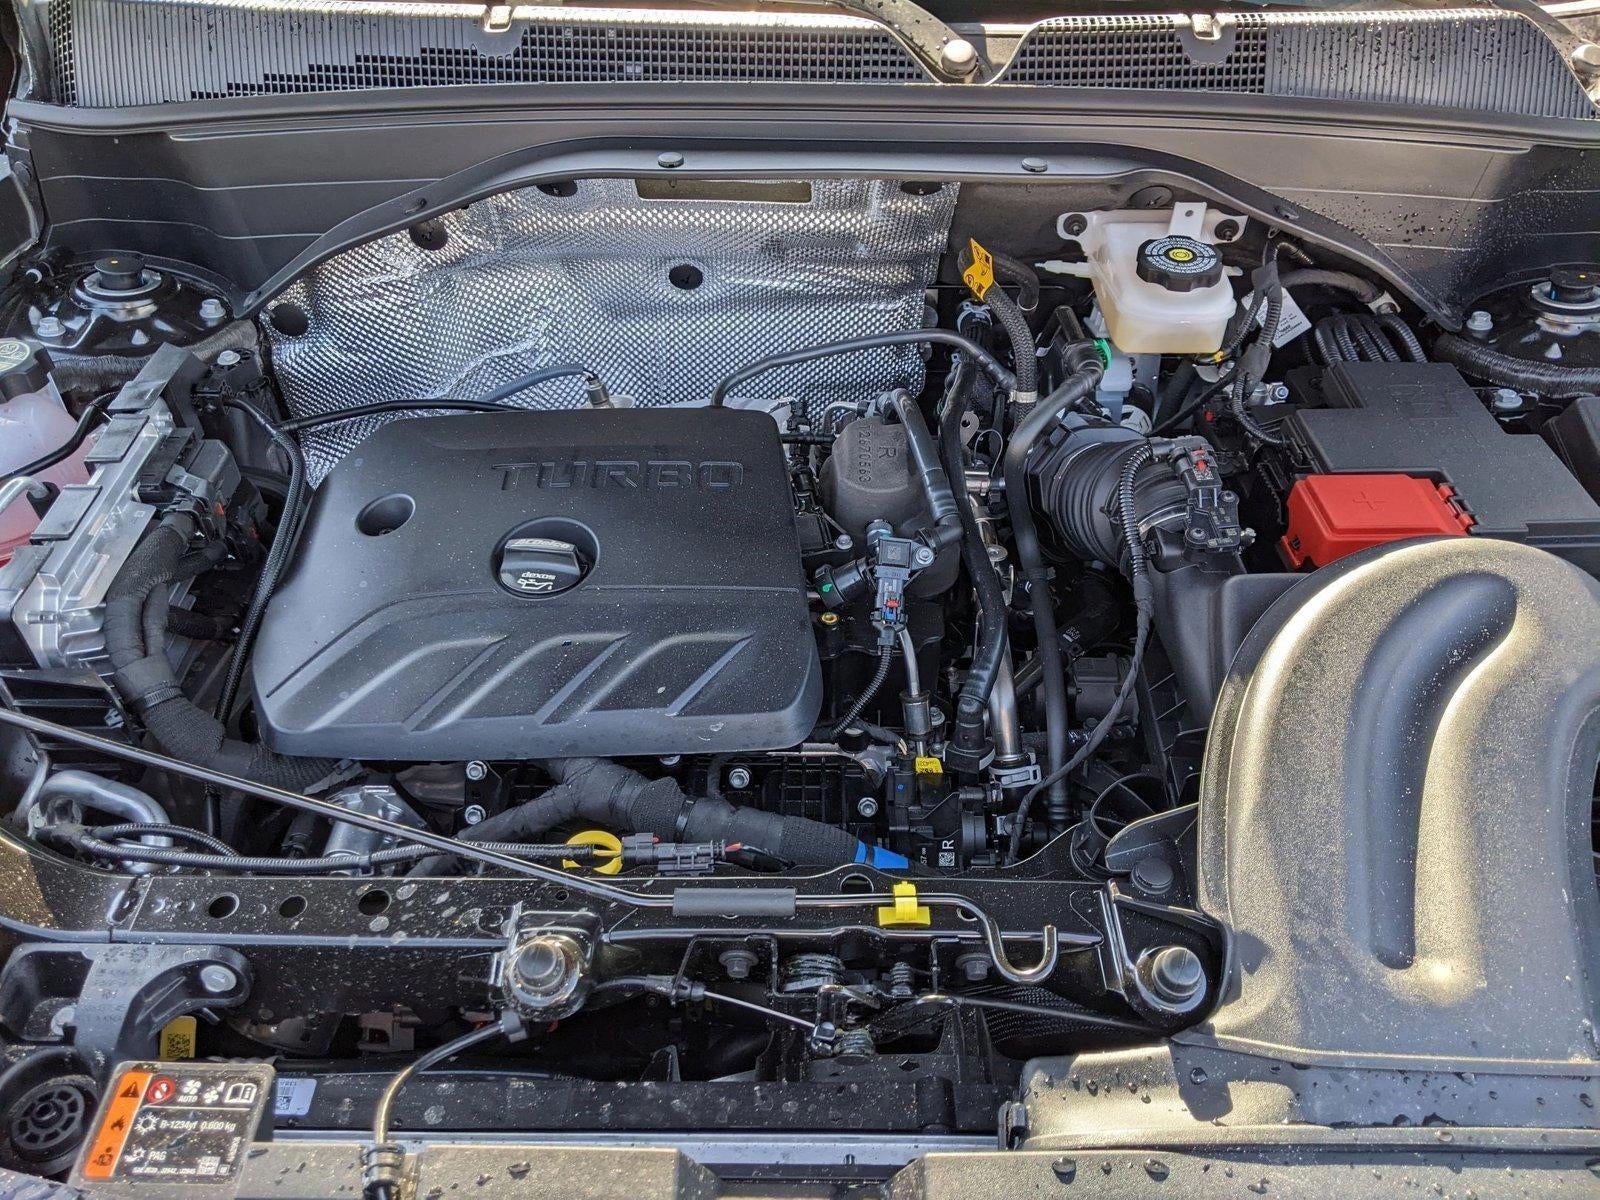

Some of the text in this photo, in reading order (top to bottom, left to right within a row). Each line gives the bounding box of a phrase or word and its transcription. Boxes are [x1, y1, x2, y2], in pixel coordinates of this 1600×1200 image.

[491, 460, 744, 490] TURBO
[521, 571, 556, 580] dexos
[941, 839, 954, 850] R
[178, 1095, 198, 1103] AUTO
